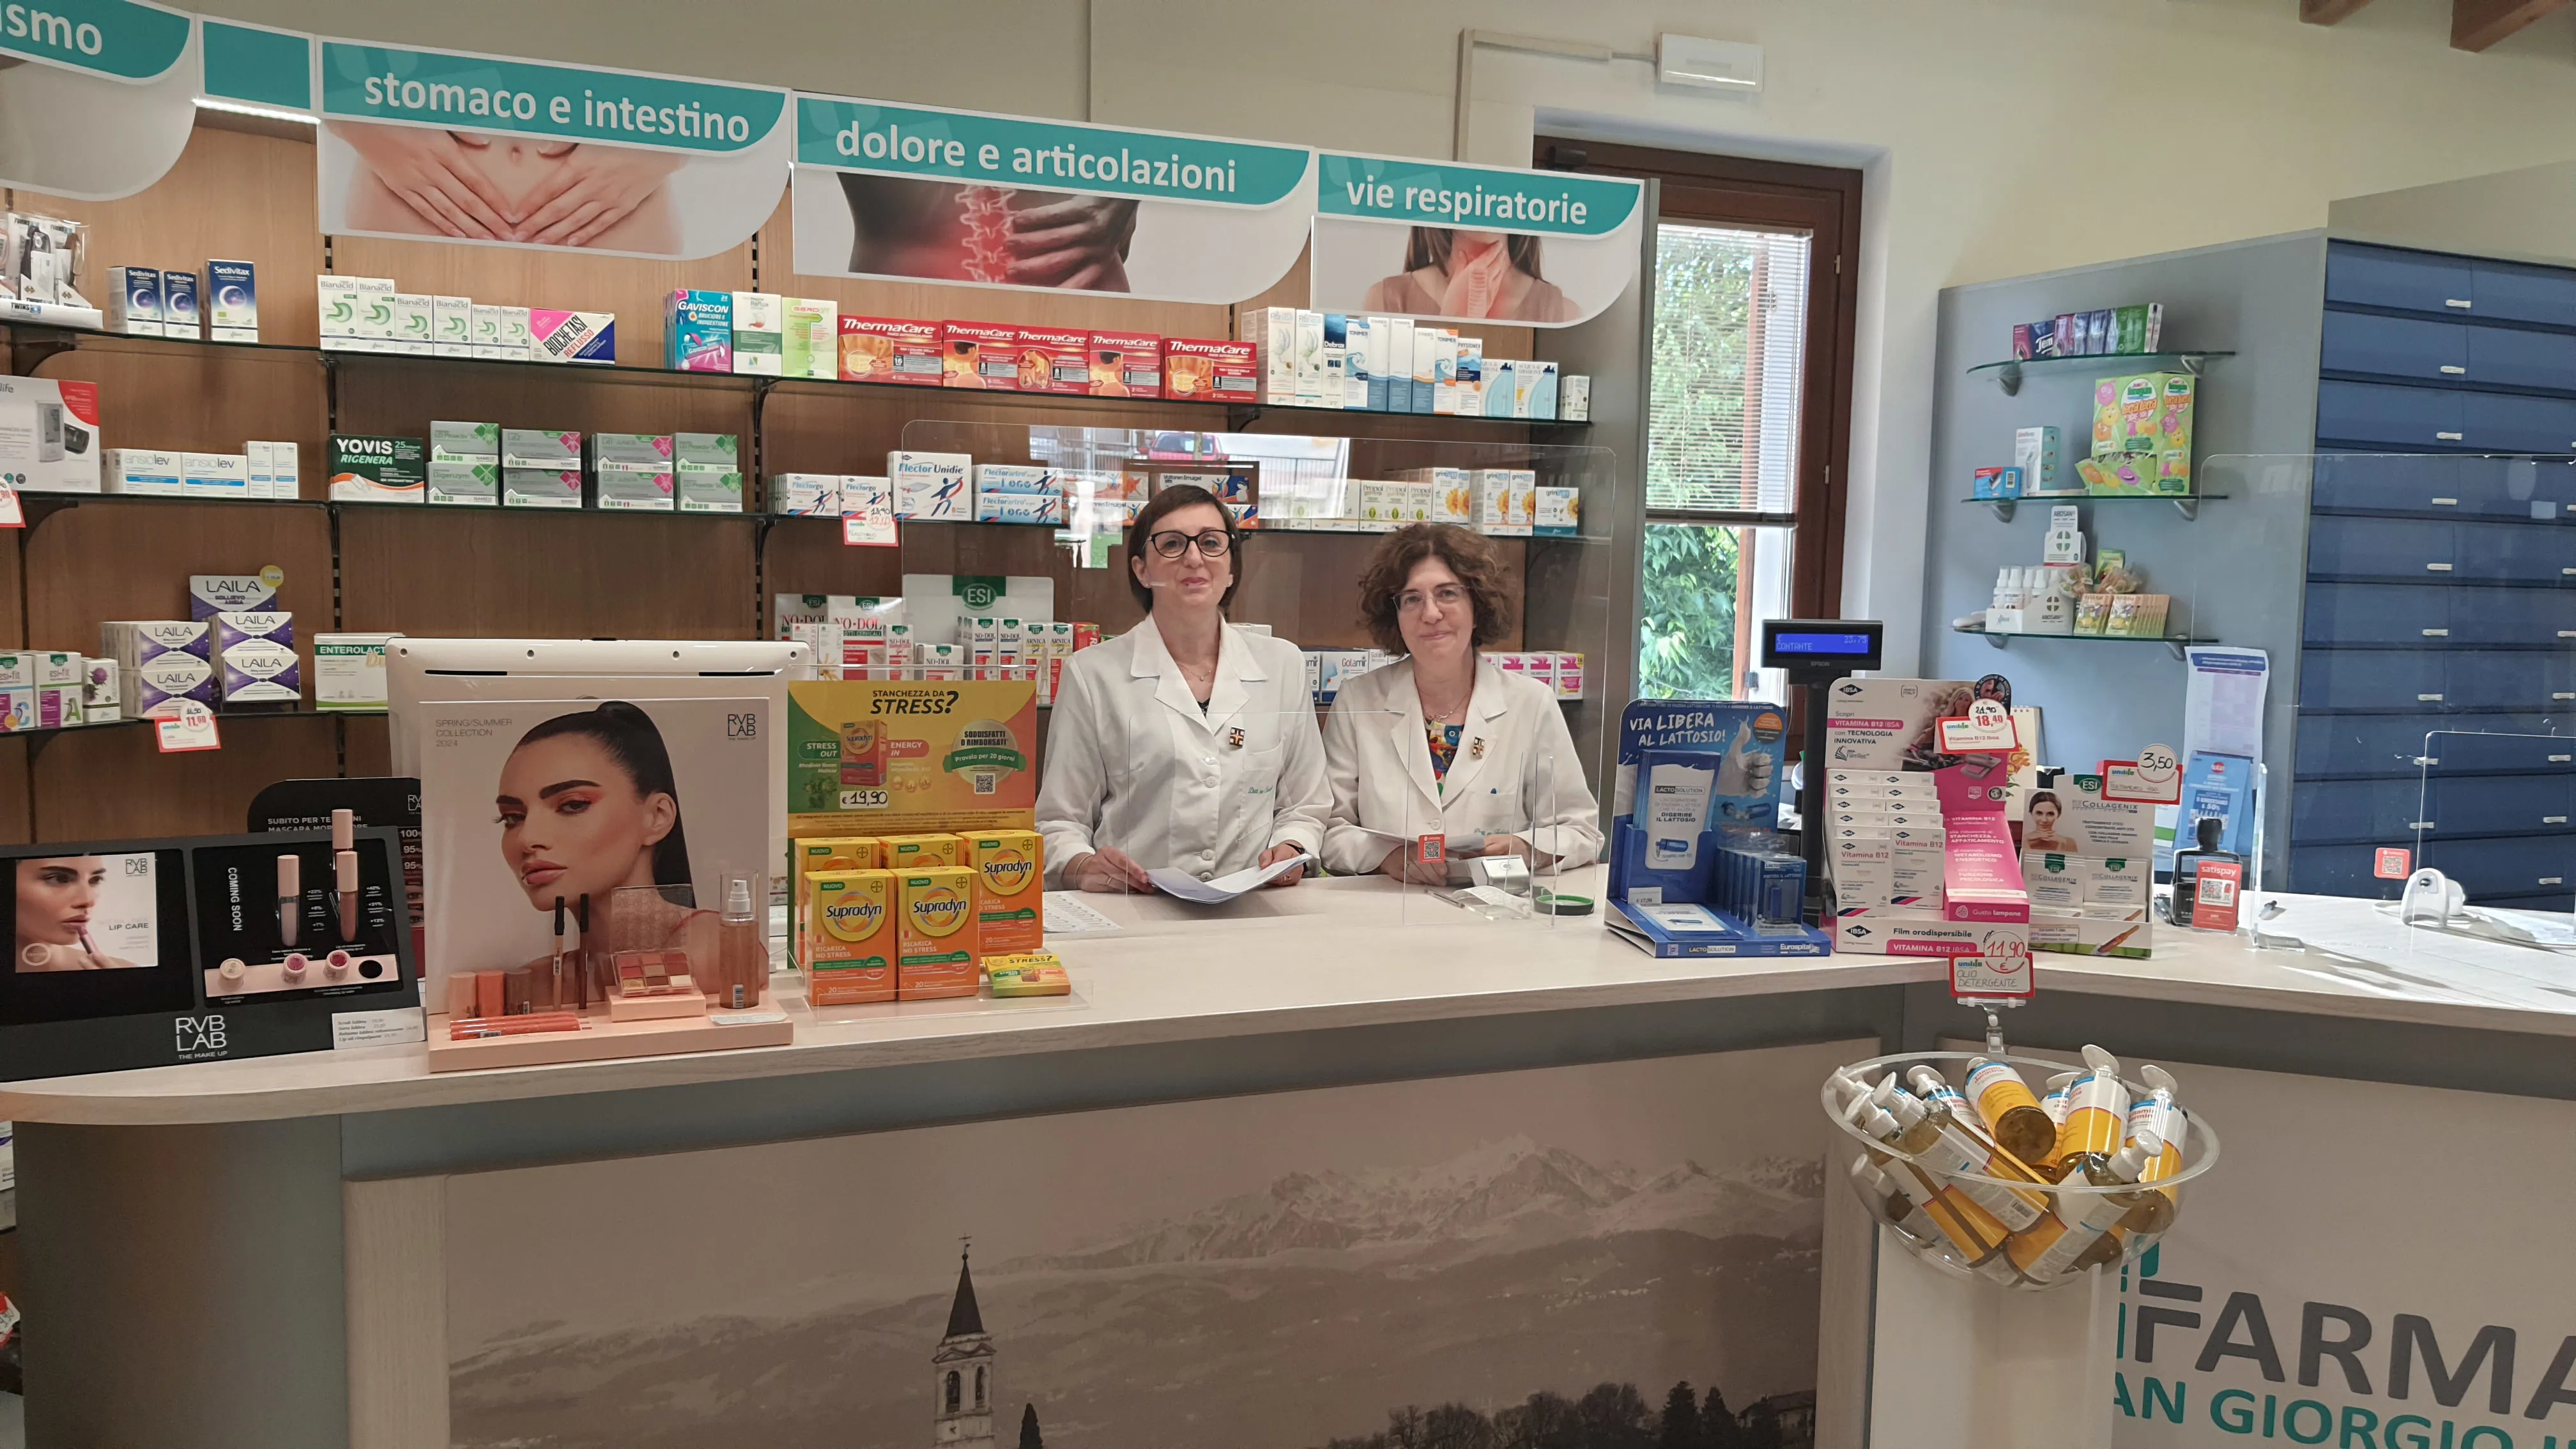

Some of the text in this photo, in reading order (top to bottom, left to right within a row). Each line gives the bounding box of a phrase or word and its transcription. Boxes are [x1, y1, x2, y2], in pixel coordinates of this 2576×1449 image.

[0, 3, 102, 55] smo
[365, 73, 749, 142] stomaco e intestino
[836, 121, 1235, 192] dolore e articolazioni
[1347, 176, 1587, 225] vie respiratorie
[128, 270, 156, 279] Sedivitax
[214, 266, 250, 276] Sedivitax
[167, 273, 194, 282] Sedivitax
[321, 280, 353, 289] Bianacid
[360, 283, 392, 292] Bianacid
[397, 298, 429, 307] Bianacid
[678, 301, 728, 314] GAVISCON
[843, 318, 935, 335] ThermaCare
[947, 325, 1015, 338] ThermaCare
[543, 314, 588, 356] BIOCHETASI
[1018, 331, 1086, 343] ThermaCare
[1093, 335, 1157, 347] ThermaCare
[564, 329, 594, 358] REFLUSSO
[1170, 341, 1250, 355] ThermaCare
[337, 438, 392, 455] YOVIS
[124, 453, 170, 467] ansiolev
[185, 457, 234, 470] ansiolev
[341, 454, 393, 465] RIGENERA
[898, 463, 963, 475] Flector Unidie
[792, 480, 823, 491] Flectorgo
[846, 483, 876, 493] Flectorgo
[206, 581, 261, 592] LAILA
[967, 588, 990, 604] ESI
[236, 615, 275, 625] LAILA
[155, 627, 193, 636] LAILA
[1776, 642, 1813, 650] CONTANTE
[241, 659, 282, 668] LAILA
[157, 673, 195, 684] LAILA
[870, 690, 959, 714] STRESS?
[436, 718, 512, 728] SPRING/SUMMER
[727, 714, 756, 724] RVB
[1630, 712, 1714, 731] VIA LIBERA
[1975, 714, 2004, 727] 18,40
[436, 728, 493, 737] COLLECTION
[727, 724, 756, 737] LAB
[964, 730, 1006, 739] SODDISFATTI
[1638, 730, 1726, 746] AL LATTOSIO!
[955, 754, 977, 762] Provalo
[998, 753, 1015, 762] giorni
[2140, 752, 2174, 772] 3,50
[2082, 780, 2098, 790] ESI
[850, 792, 888, 806] 19,90
[983, 859, 1032, 875] Supradyn
[2201, 866, 2237, 877] satispay
[227, 867, 242, 931] COMING SOON
[826, 904, 882, 919] Supradyn
[914, 900, 967, 915] Supradyn
[1993, 910, 2021, 918] lampone
[1913, 929, 1972, 938] orodispersibile
[1780, 943, 1812, 952] Eurospital
[1985, 940, 2025, 961] 11,90
[1956, 970, 1977, 978] OLIO
[1958, 978, 2017, 987] DETERGENTE
[176, 1015, 225, 1034] RVB
[176, 1032, 227, 1052] LAB
[2113, 1371, 2513, 1449] AN GIORGIO
